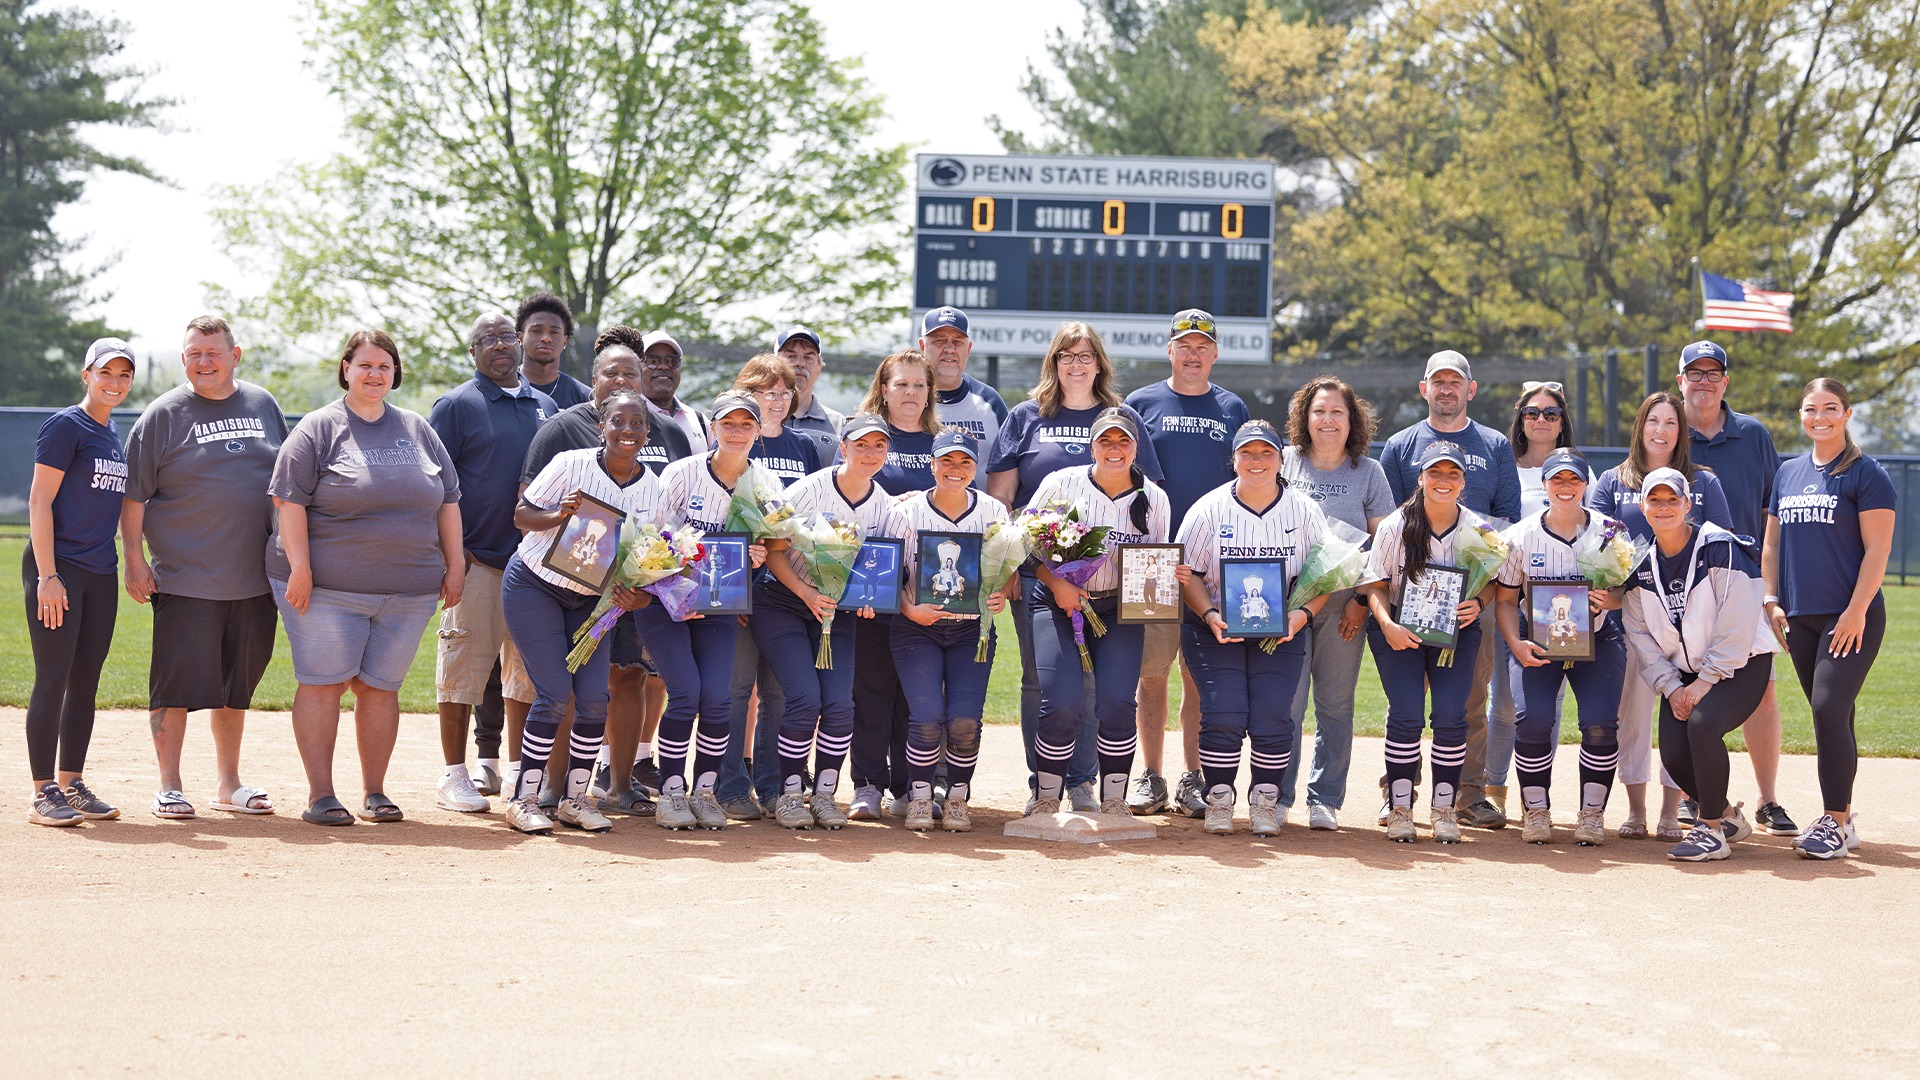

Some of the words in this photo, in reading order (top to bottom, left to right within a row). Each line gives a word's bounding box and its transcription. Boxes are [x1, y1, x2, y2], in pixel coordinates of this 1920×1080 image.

[972, 164, 1033, 183] PENN
[1040, 166, 1109, 186] STATE
[1116, 168, 1267, 190] HARRISBURG
[925, 204, 963, 226] BALL
[972, 196, 995, 232] 0
[1035, 206, 1092, 229] STRIKE
[1103, 199, 1126, 236] 0
[1179, 210, 1211, 233] OUT
[1221, 203, 1244, 240] 0
[1033, 237, 1042, 255] 1
[1052, 238, 1064, 256] 2
[1073, 238, 1085, 256] 3
[1095, 239, 1106, 257] 4
[1115, 240, 1127, 258] 5
[1136, 240, 1148, 258] 6
[1158, 241, 1169, 259] 7
[1179, 241, 1190, 260] 8
[1226, 243, 1262, 261] TOTAL
[938, 259, 997, 281] GUESTS
[944, 286, 988, 308] HOME
[194, 417, 263, 437] HARRISBURG
[1040, 426, 1090, 437] HARRISB
[1199, 417, 1228, 434] SOFTBALL
[1292, 479, 1316, 491] PENN
[1318, 483, 1348, 494] STATE
[1778, 507, 1835, 525] SOFTBALL
[1220, 545, 1257, 557] PENN
[1259, 546, 1297, 557] STATE
